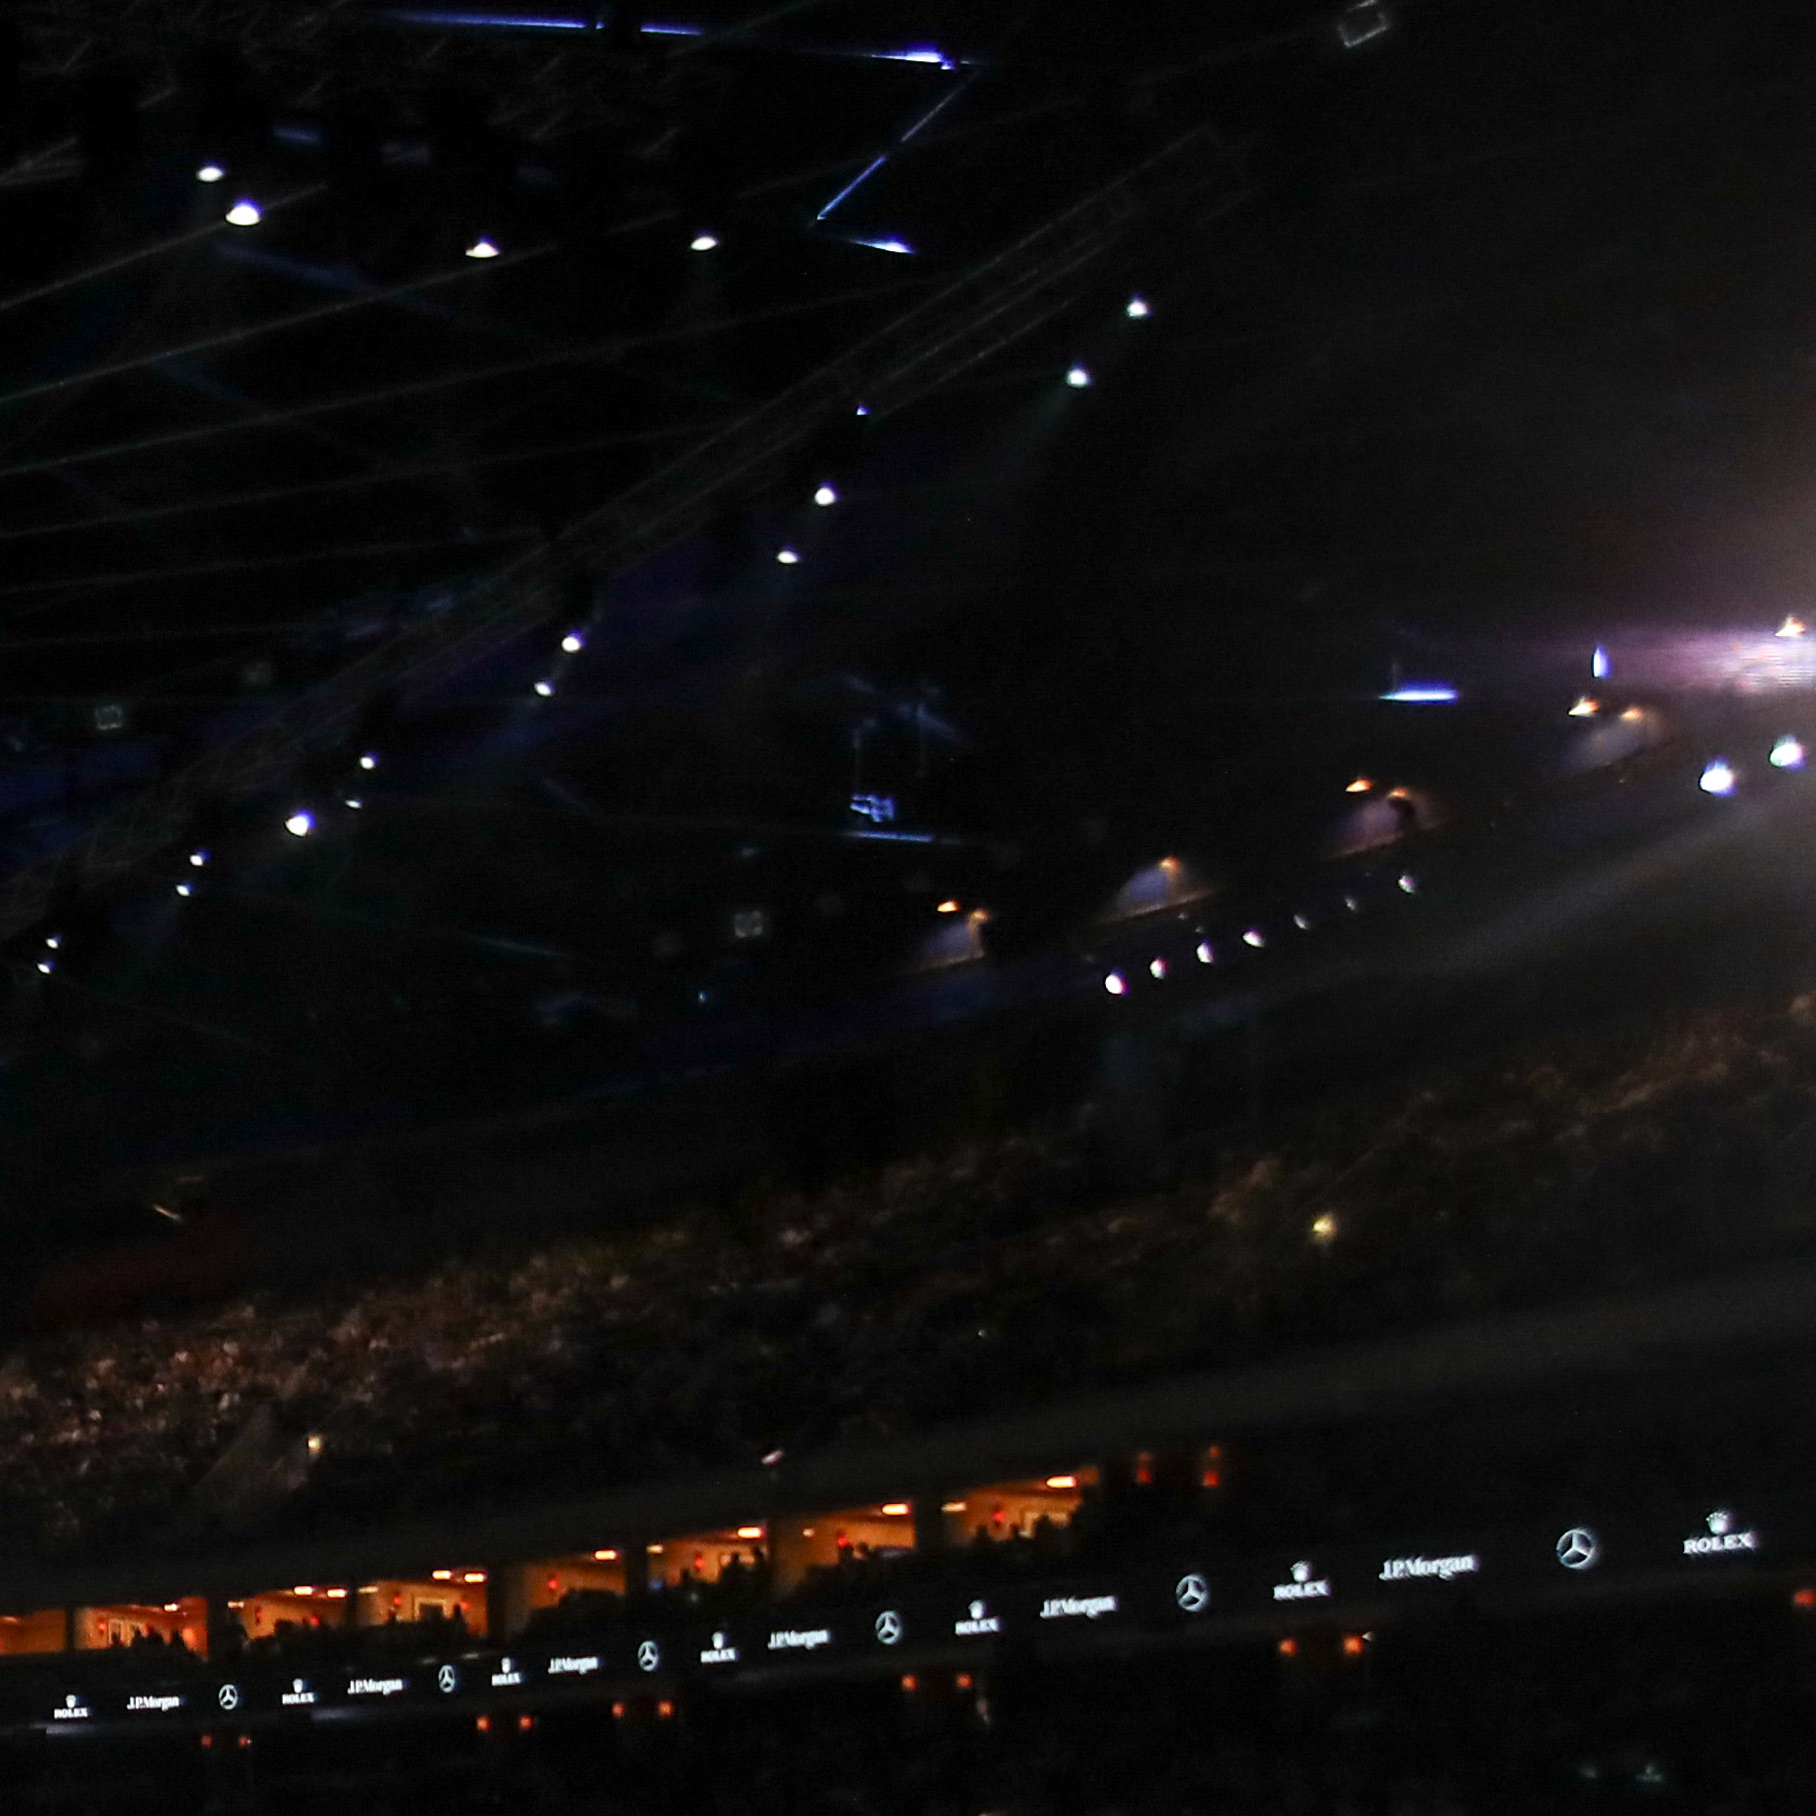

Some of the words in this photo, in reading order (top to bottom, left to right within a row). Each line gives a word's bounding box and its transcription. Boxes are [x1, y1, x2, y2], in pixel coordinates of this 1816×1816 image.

[1684, 1532, 1754, 1554] ROLEX
[1274, 1578, 1328, 1600] ROLEX
[955, 1616, 998, 1635] ROLEX
[701, 1648, 735, 1663] ROLEX
[348, 1679, 403, 1695] J.P.Morgan
[492, 1673, 521, 1686] ROLEX
[127, 1696, 179, 1711] J.P.Morgan
[282, 1692, 314, 1704] ROLEX
[54, 1708, 88, 1718] ROLEX
